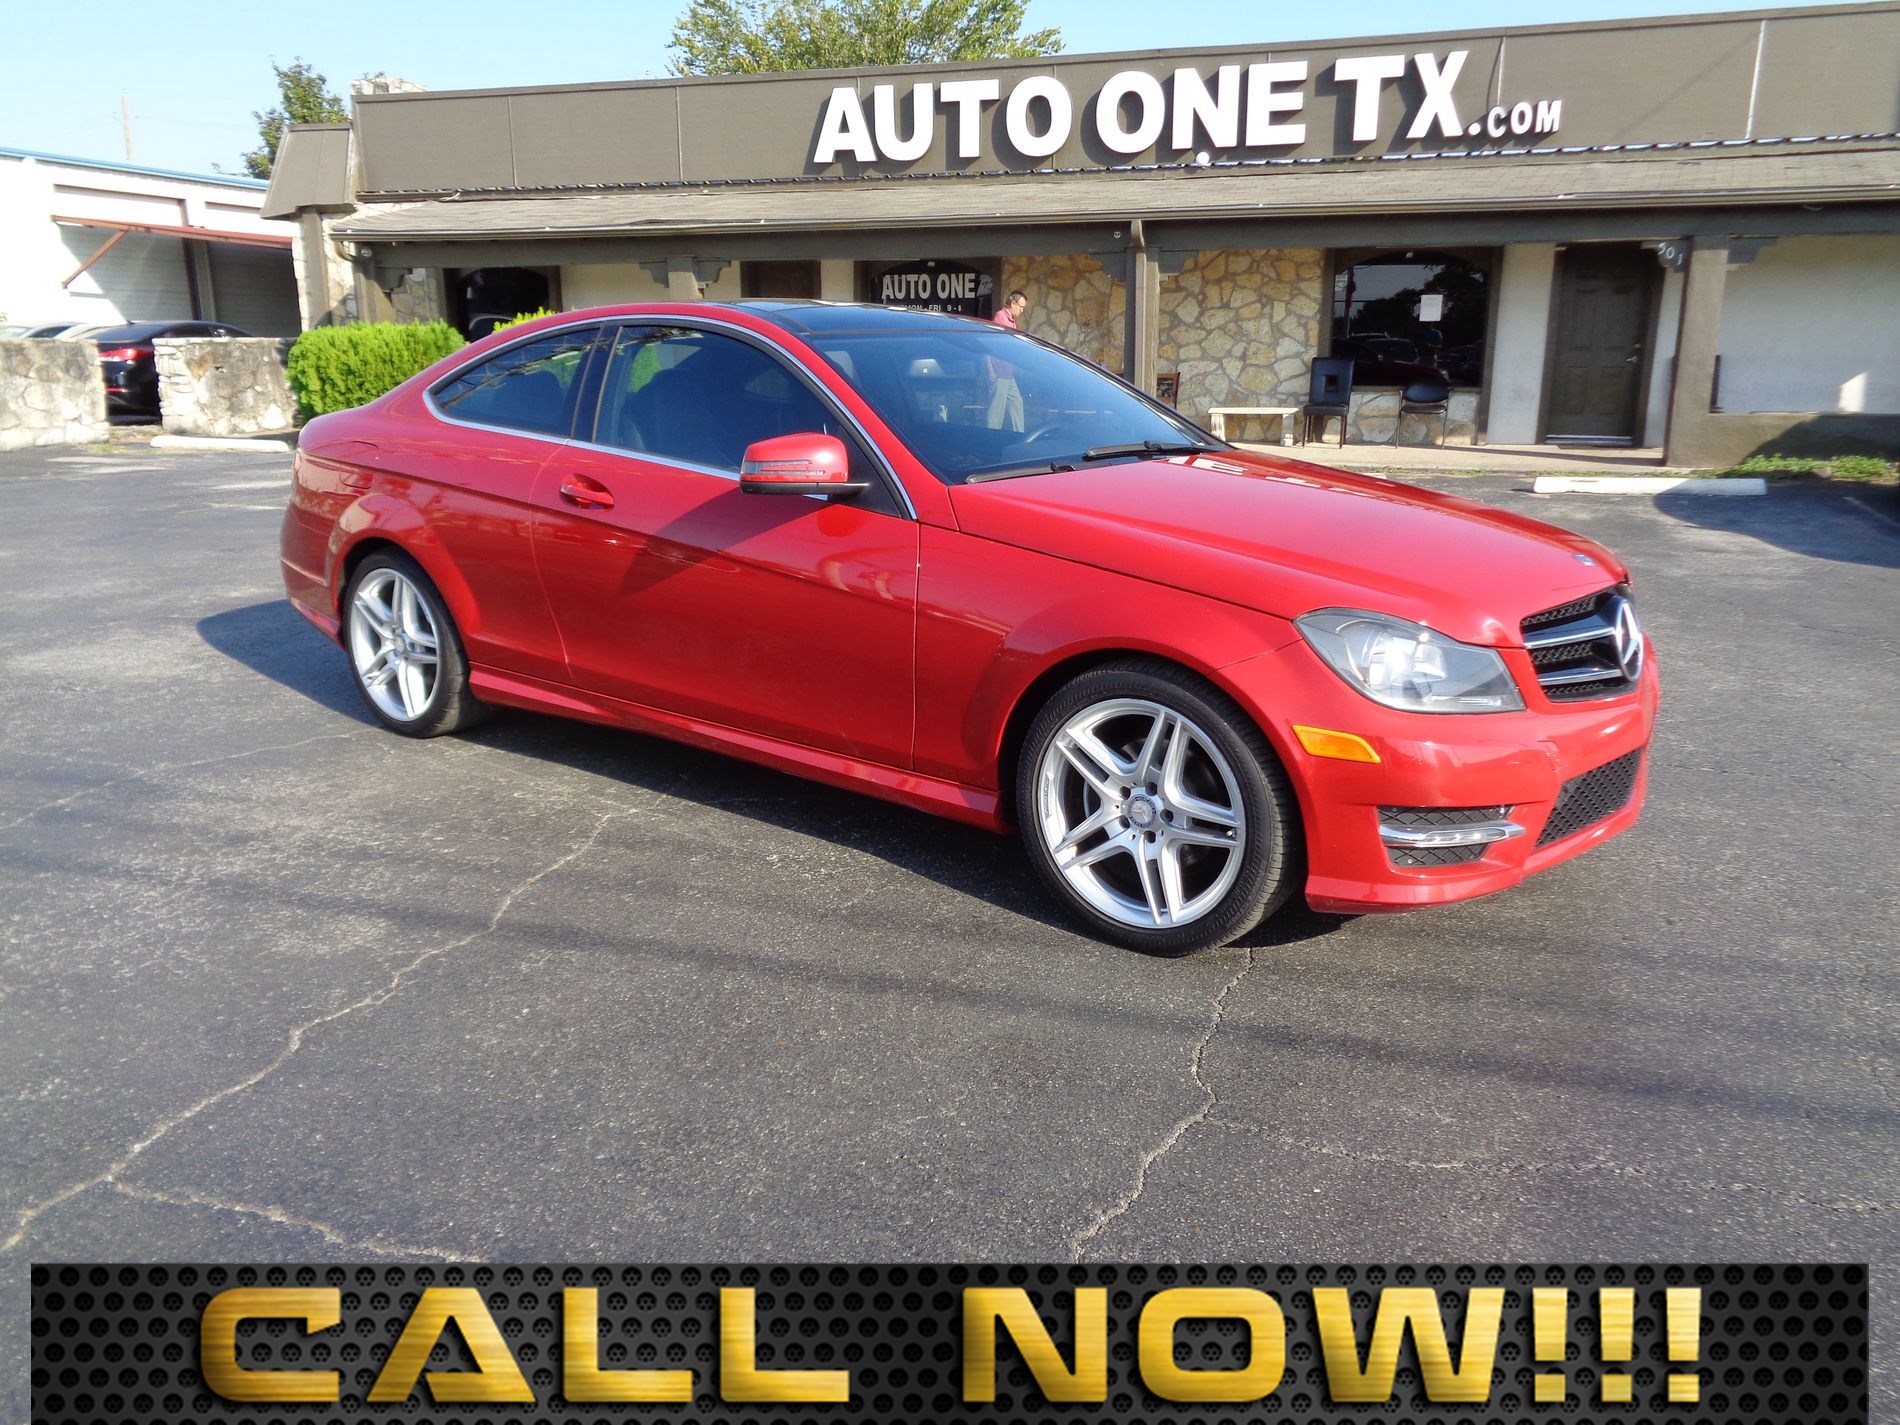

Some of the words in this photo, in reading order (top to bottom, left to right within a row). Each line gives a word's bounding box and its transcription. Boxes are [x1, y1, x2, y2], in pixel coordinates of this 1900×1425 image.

[813, 75, 1073, 164] AUTO
[1095, 60, 1308, 154] ONE
[881, 273, 931, 300] AUTO
[936, 272, 976, 299] ONE
[928, 304, 942, 312] FRI
